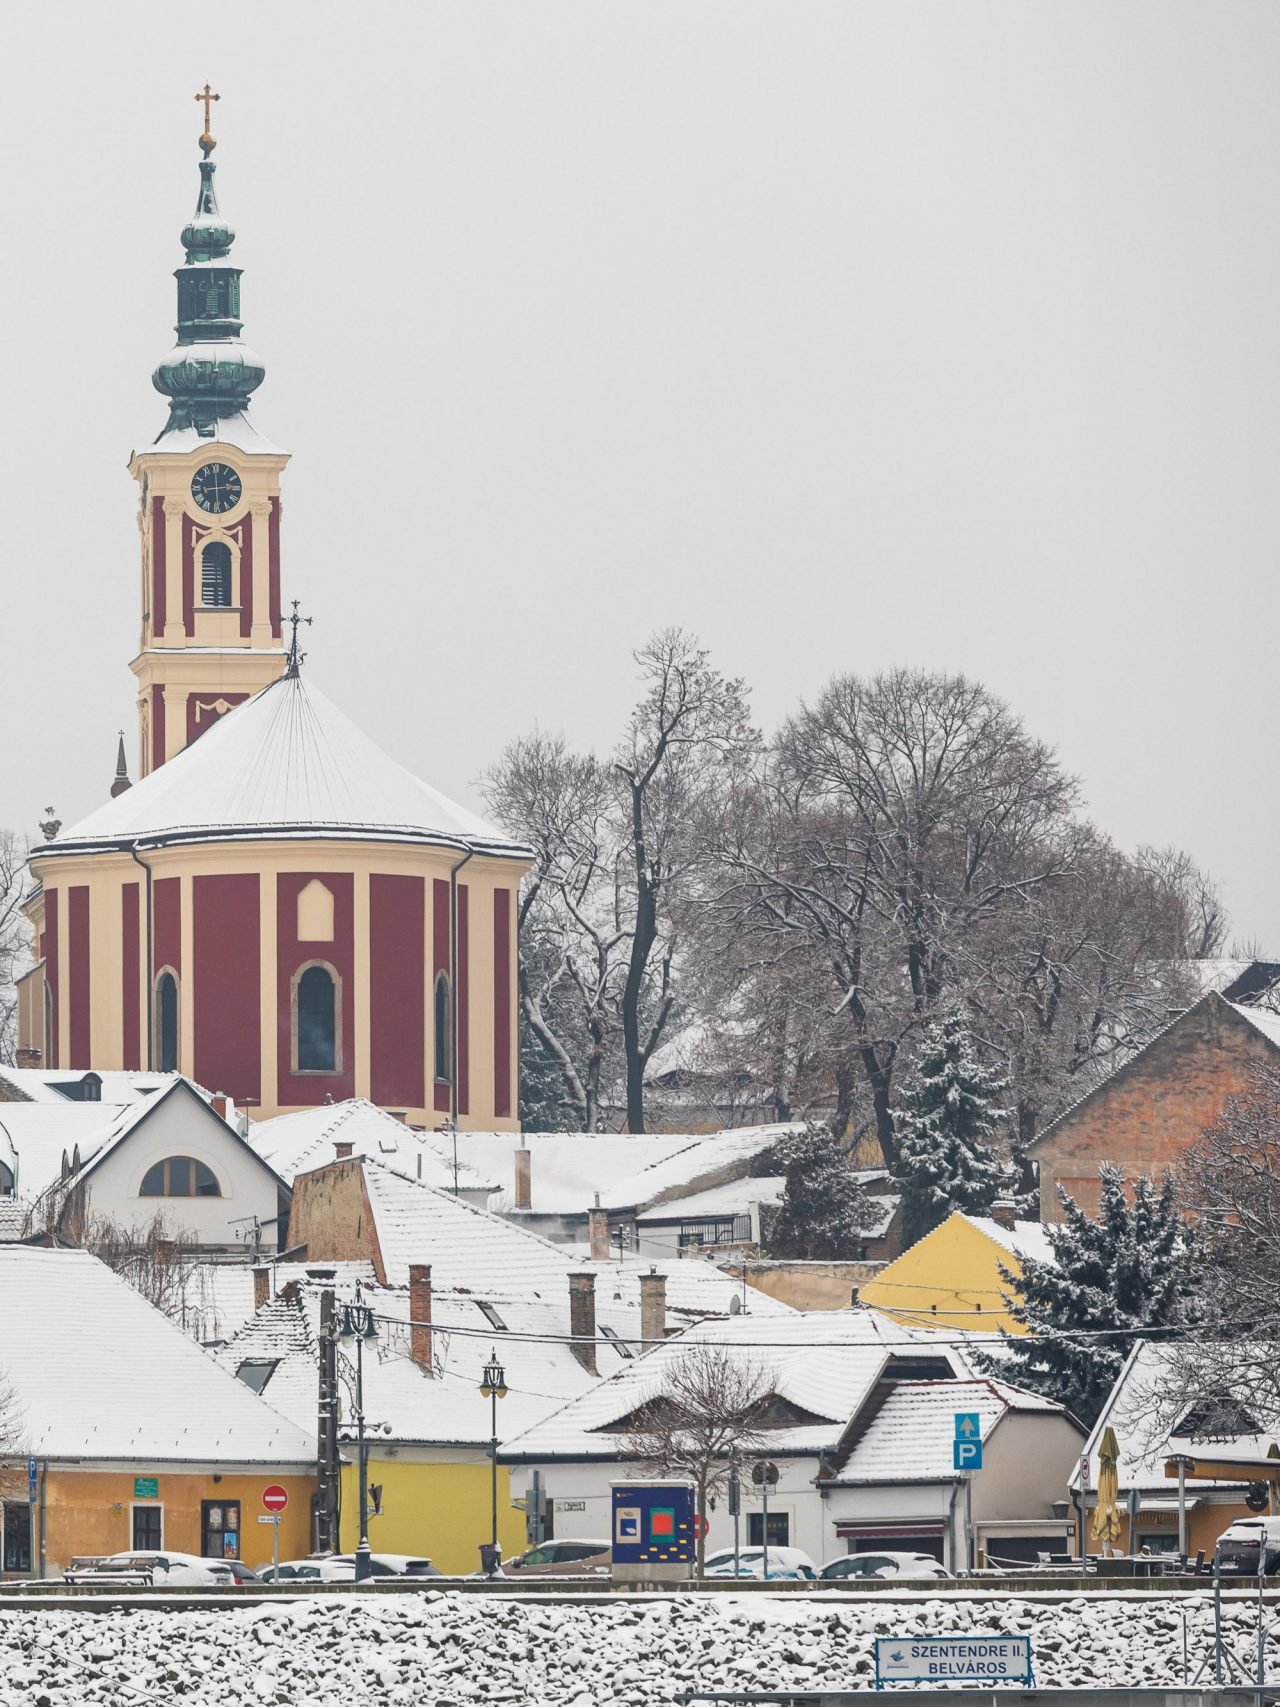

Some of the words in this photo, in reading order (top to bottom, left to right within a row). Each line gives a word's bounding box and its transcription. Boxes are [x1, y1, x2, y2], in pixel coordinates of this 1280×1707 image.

[959, 1443, 977, 1466] P
[911, 1645, 1008, 1658] SZENTENDRE
[1012, 1645, 1025, 1657] II.
[928, 1659, 1008, 1674] BELVÁROS
